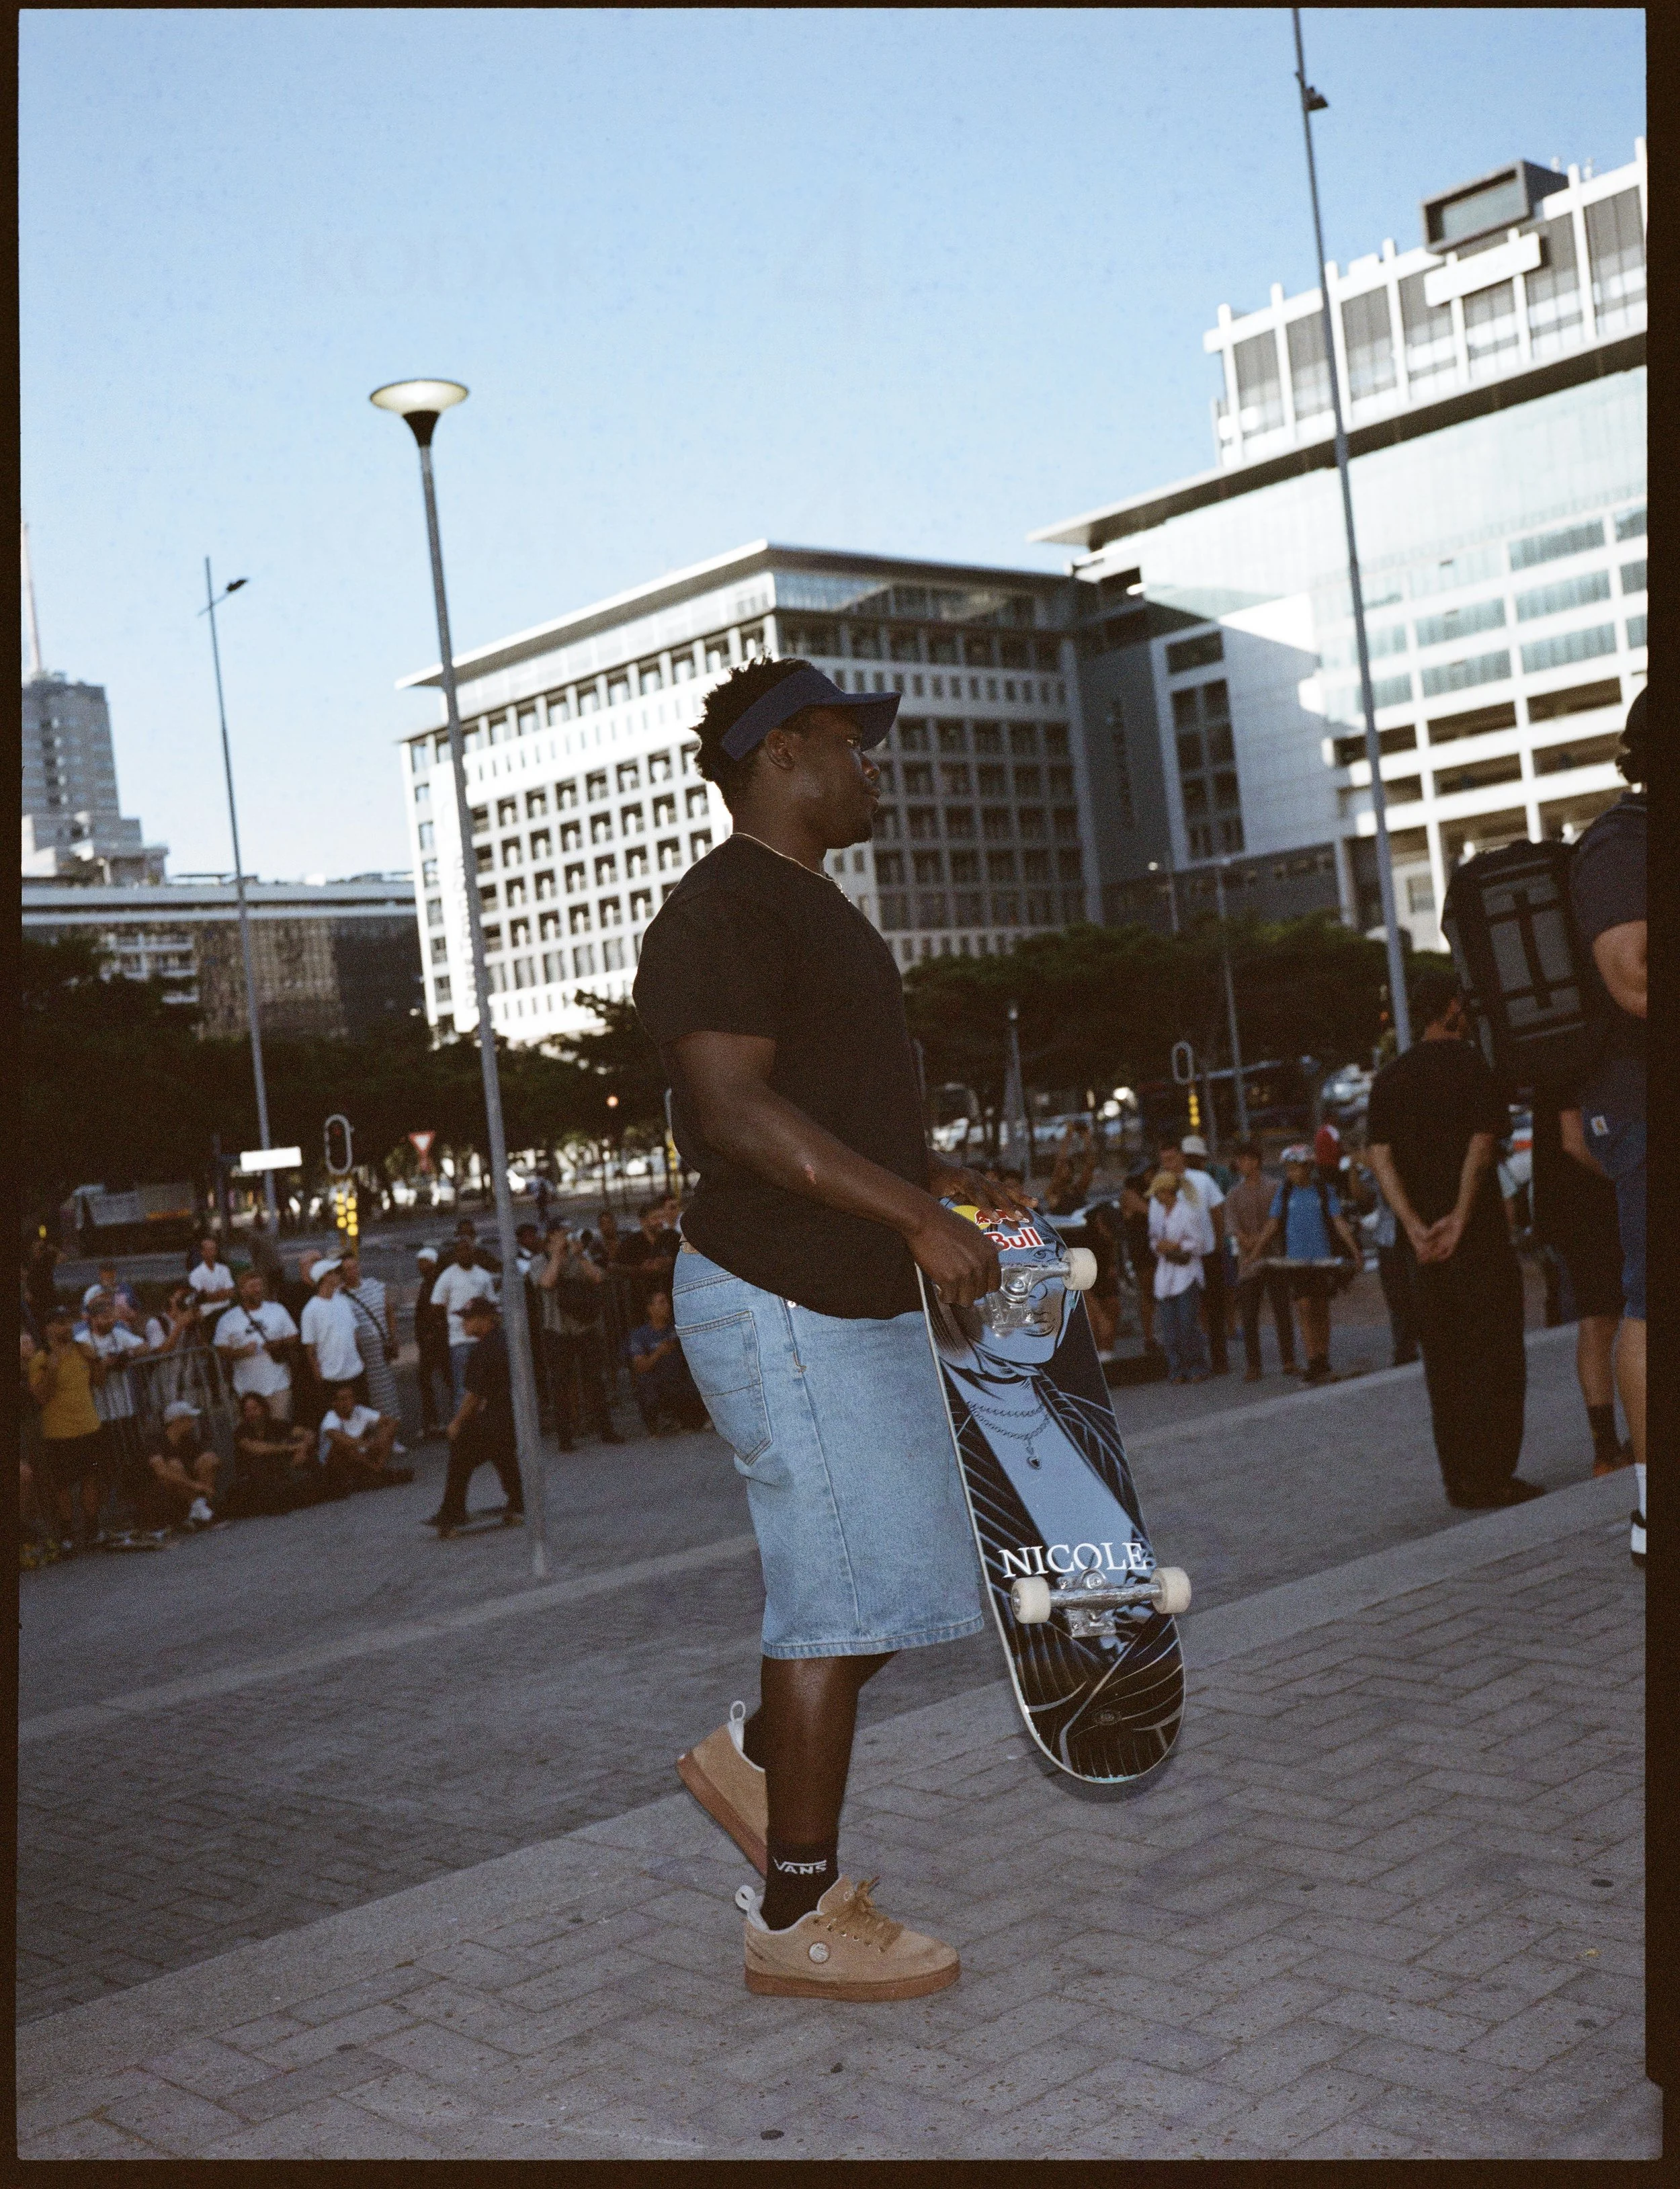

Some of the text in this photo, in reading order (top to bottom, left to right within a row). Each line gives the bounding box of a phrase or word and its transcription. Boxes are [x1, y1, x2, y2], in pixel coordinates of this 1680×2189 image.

[984, 1227, 1045, 1251] Bull
[998, 1542, 1147, 1578] NICOLE
[771, 1856, 827, 1874] VANS
